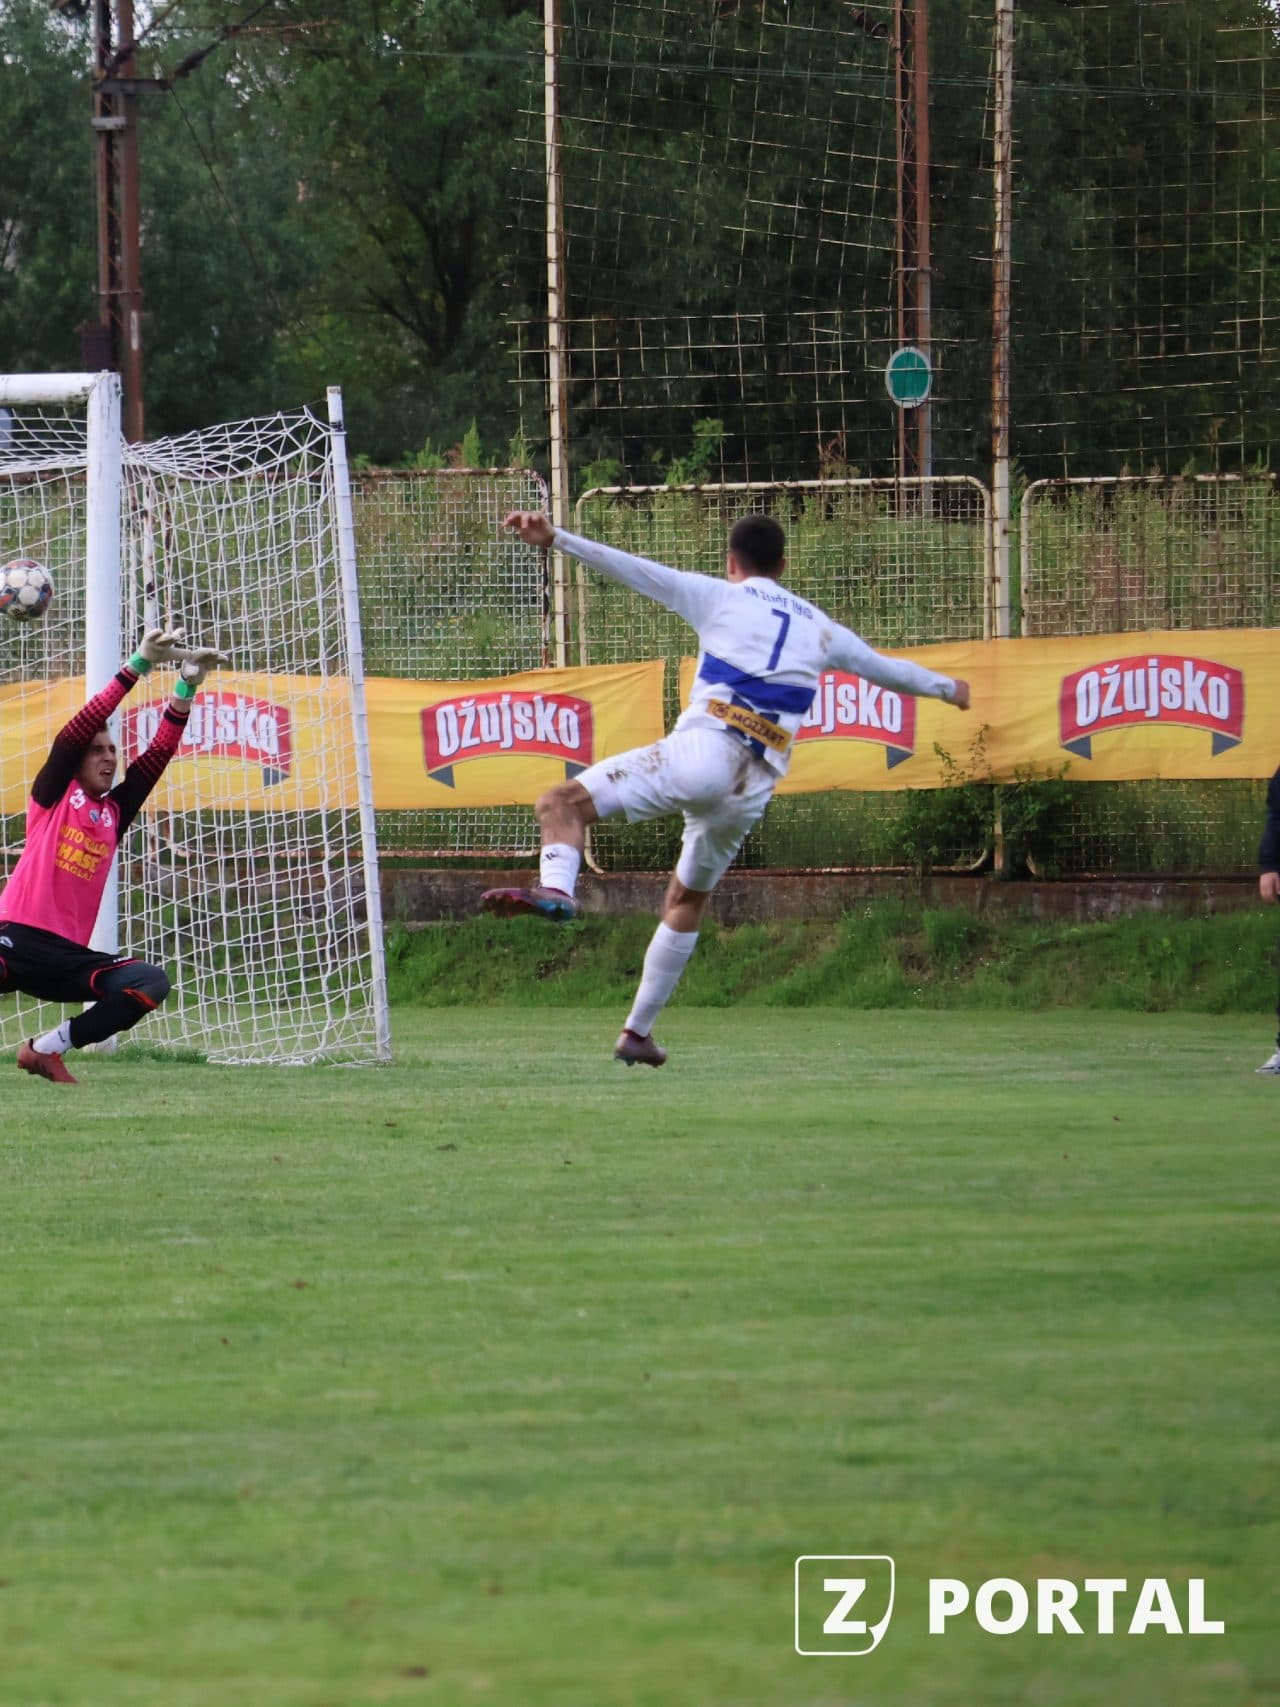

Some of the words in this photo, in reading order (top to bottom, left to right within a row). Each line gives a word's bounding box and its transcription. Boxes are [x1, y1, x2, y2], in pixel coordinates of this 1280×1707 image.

[766, 607, 791, 671] 7
[1076, 658, 1229, 727] Ožujsko
[436, 694, 580, 757] Ožujsko
